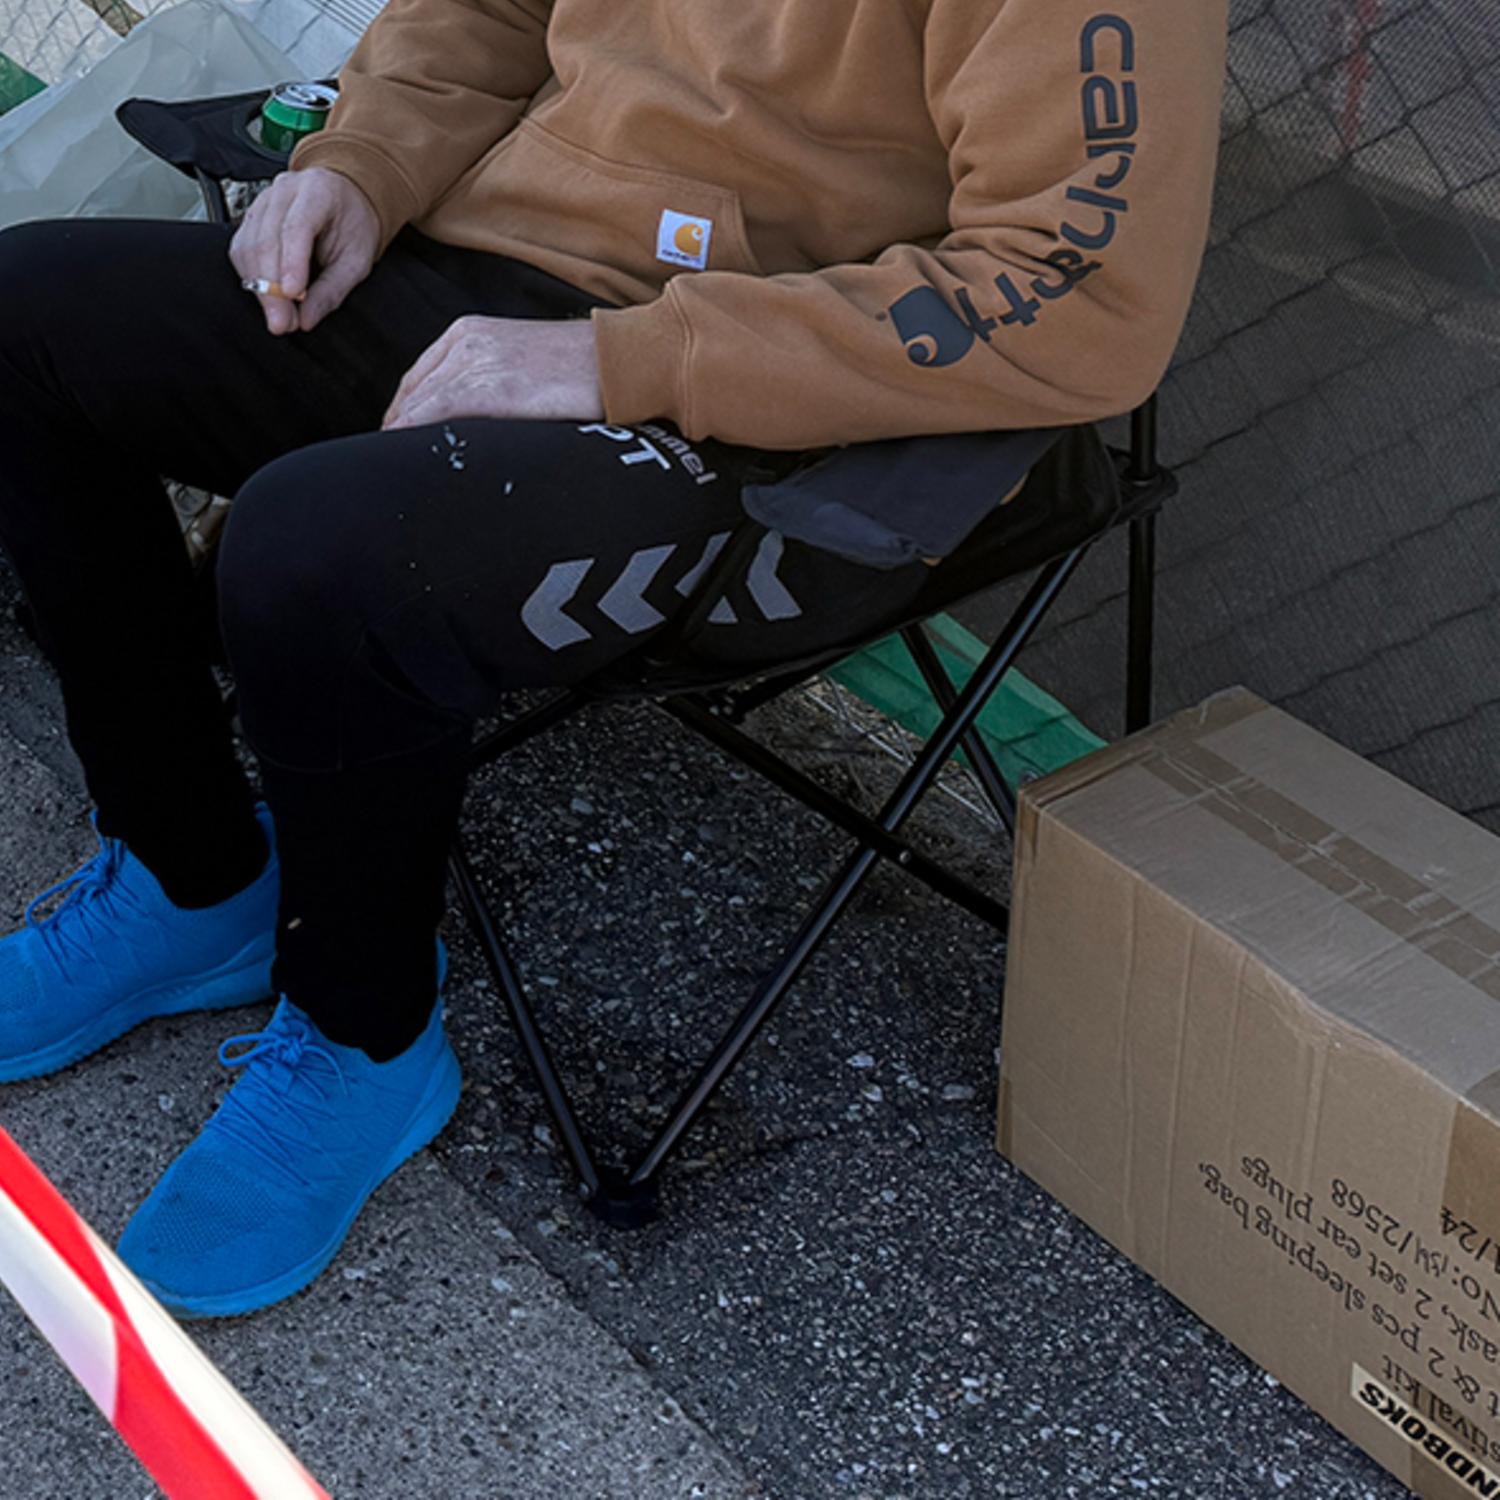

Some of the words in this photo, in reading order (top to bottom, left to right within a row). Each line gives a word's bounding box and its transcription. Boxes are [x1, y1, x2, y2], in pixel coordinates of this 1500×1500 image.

[1199, 1162, 1250, 1230] bag,
[1241, 1156, 1314, 1224] plugs
[1255, 1204, 1366, 1311] sleeping
[1317, 1216, 1362, 1259] ear
[1367, 1252, 1408, 1294] set
[1372, 1304, 1421, 1354] pcs
[1414, 1288, 1434, 1320] 2
[1382, 1354, 1422, 1409] kit
[1428, 1346, 1446, 1378] 2
[1452, 1365, 1481, 1404] &
[1359, 1382, 1500, 1500] NDBOKS
